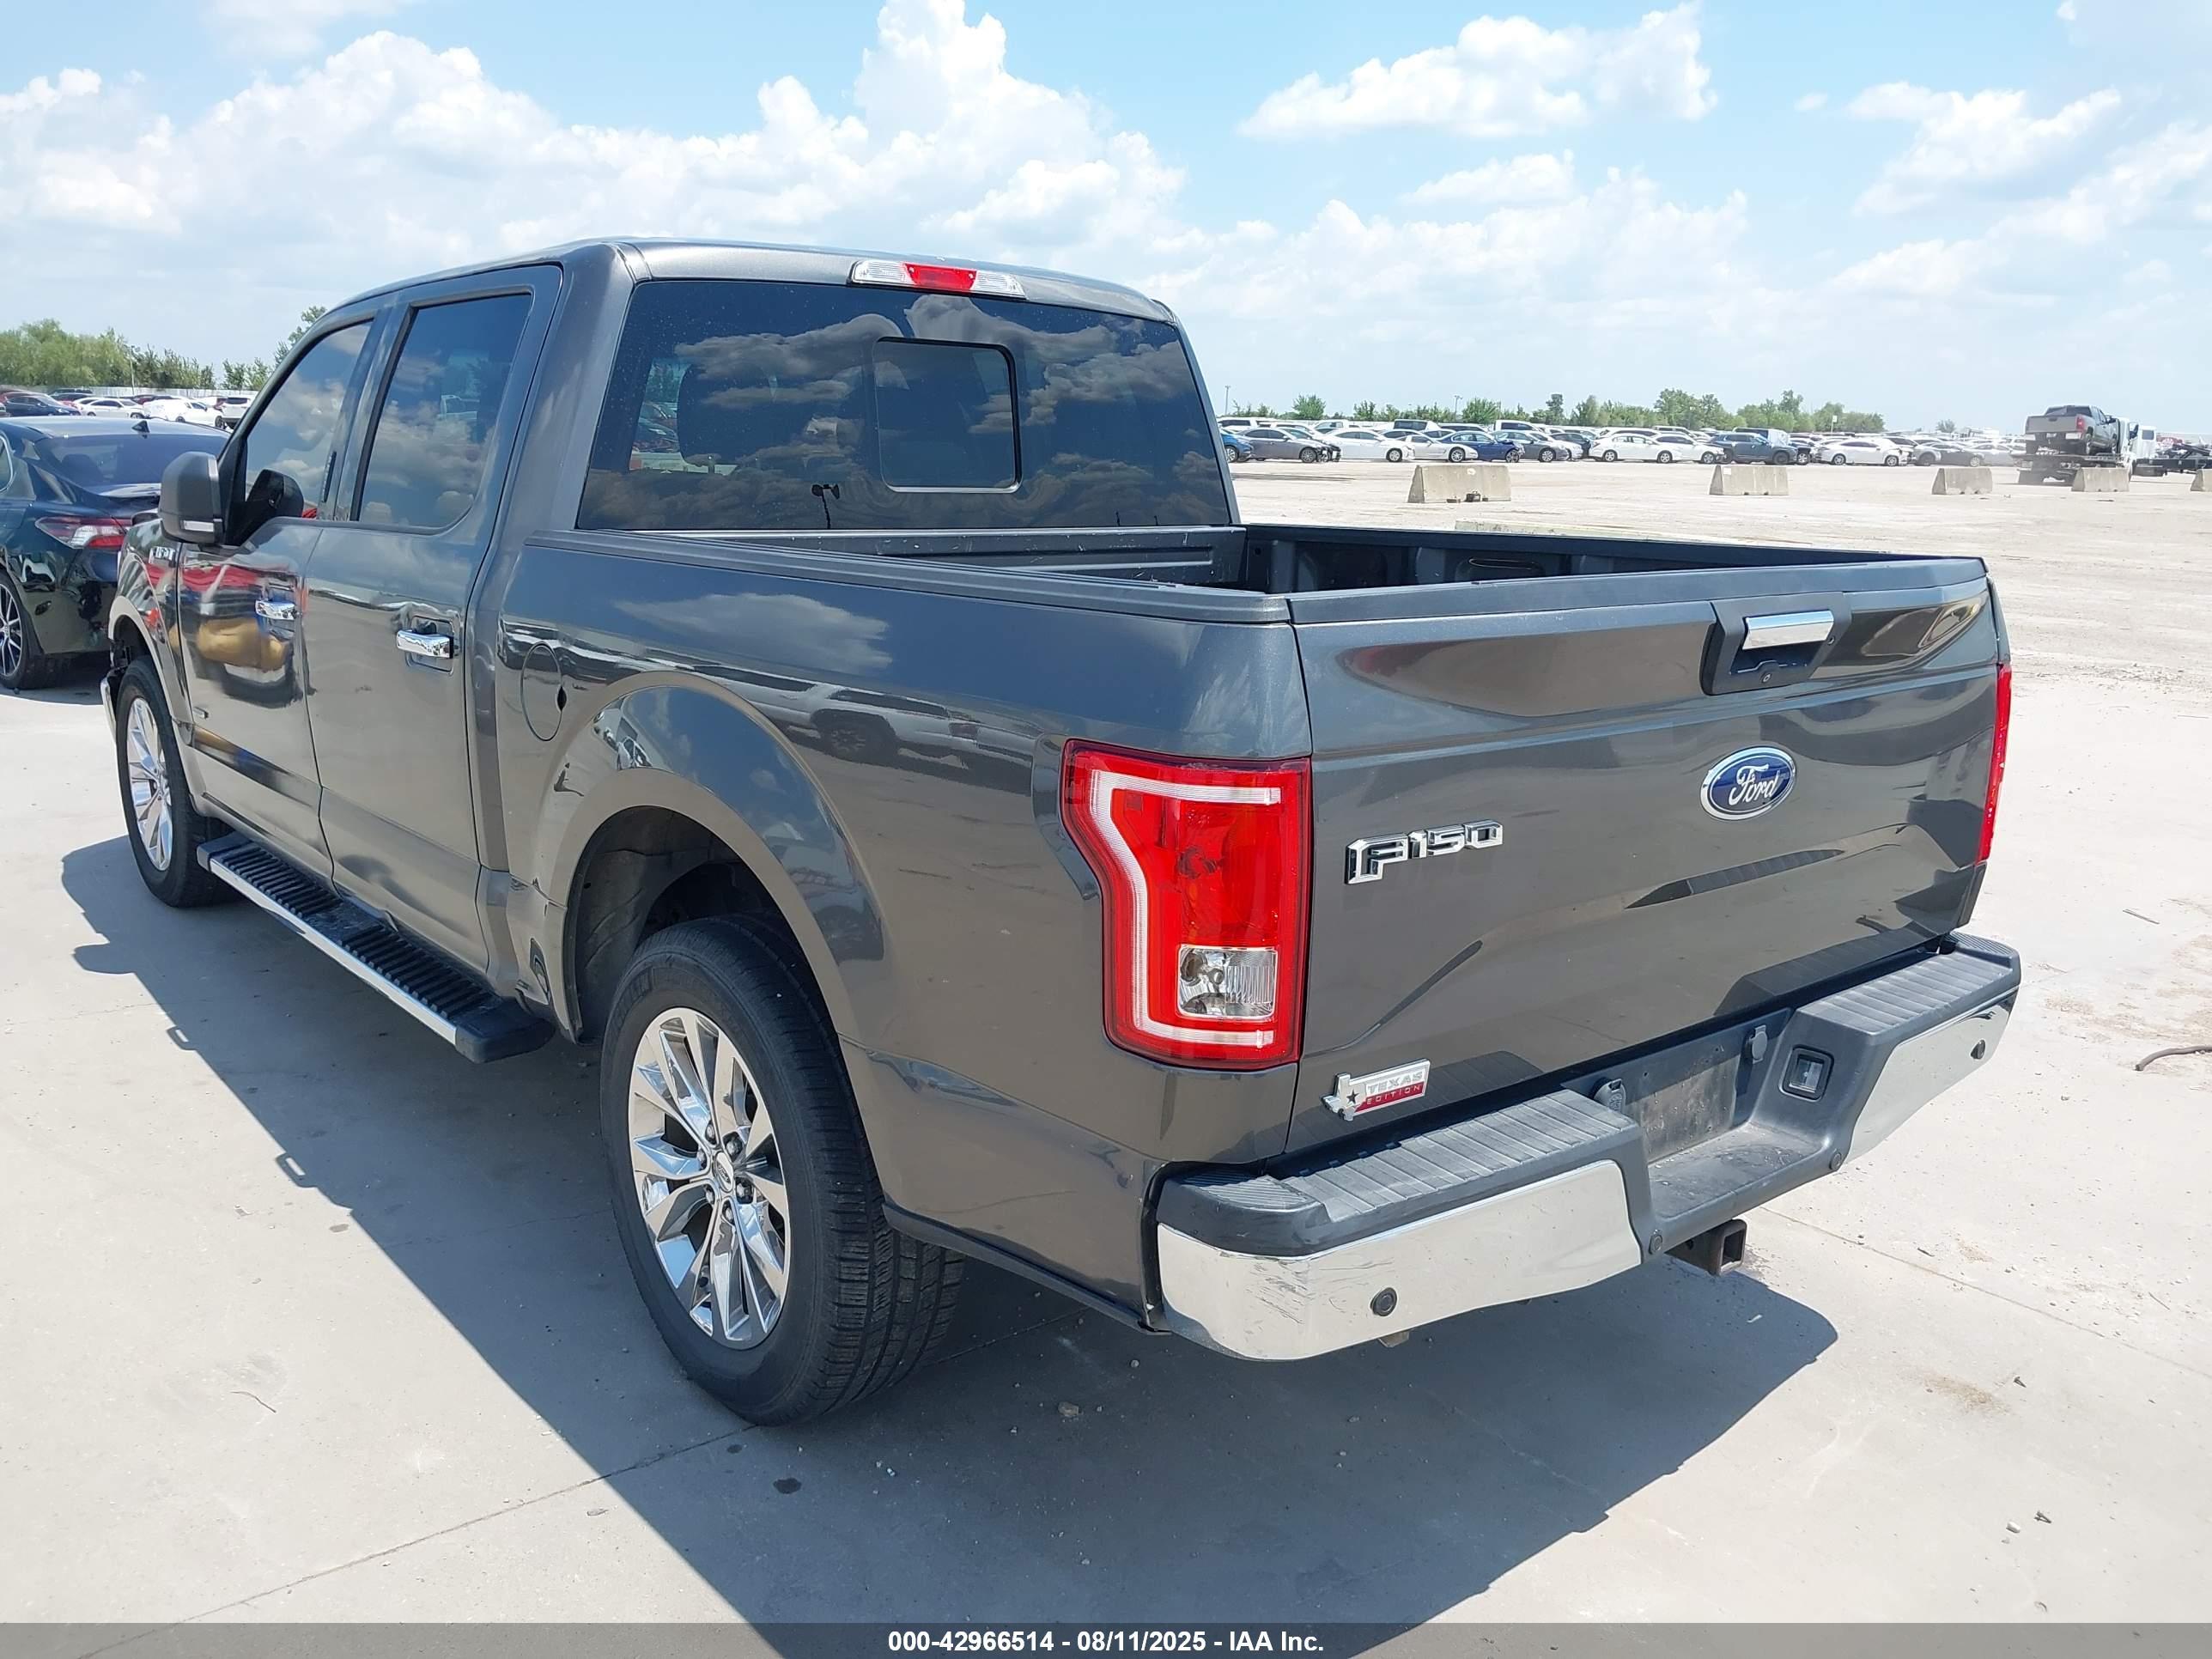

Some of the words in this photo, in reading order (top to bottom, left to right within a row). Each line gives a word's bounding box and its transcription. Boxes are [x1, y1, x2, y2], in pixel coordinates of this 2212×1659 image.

[1728, 763, 1780, 806] Ford
[1344, 818, 1504, 884] F150
[1365, 1084, 1422, 1106] EDITION
[1366, 1070, 1424, 1094] TEXAS
